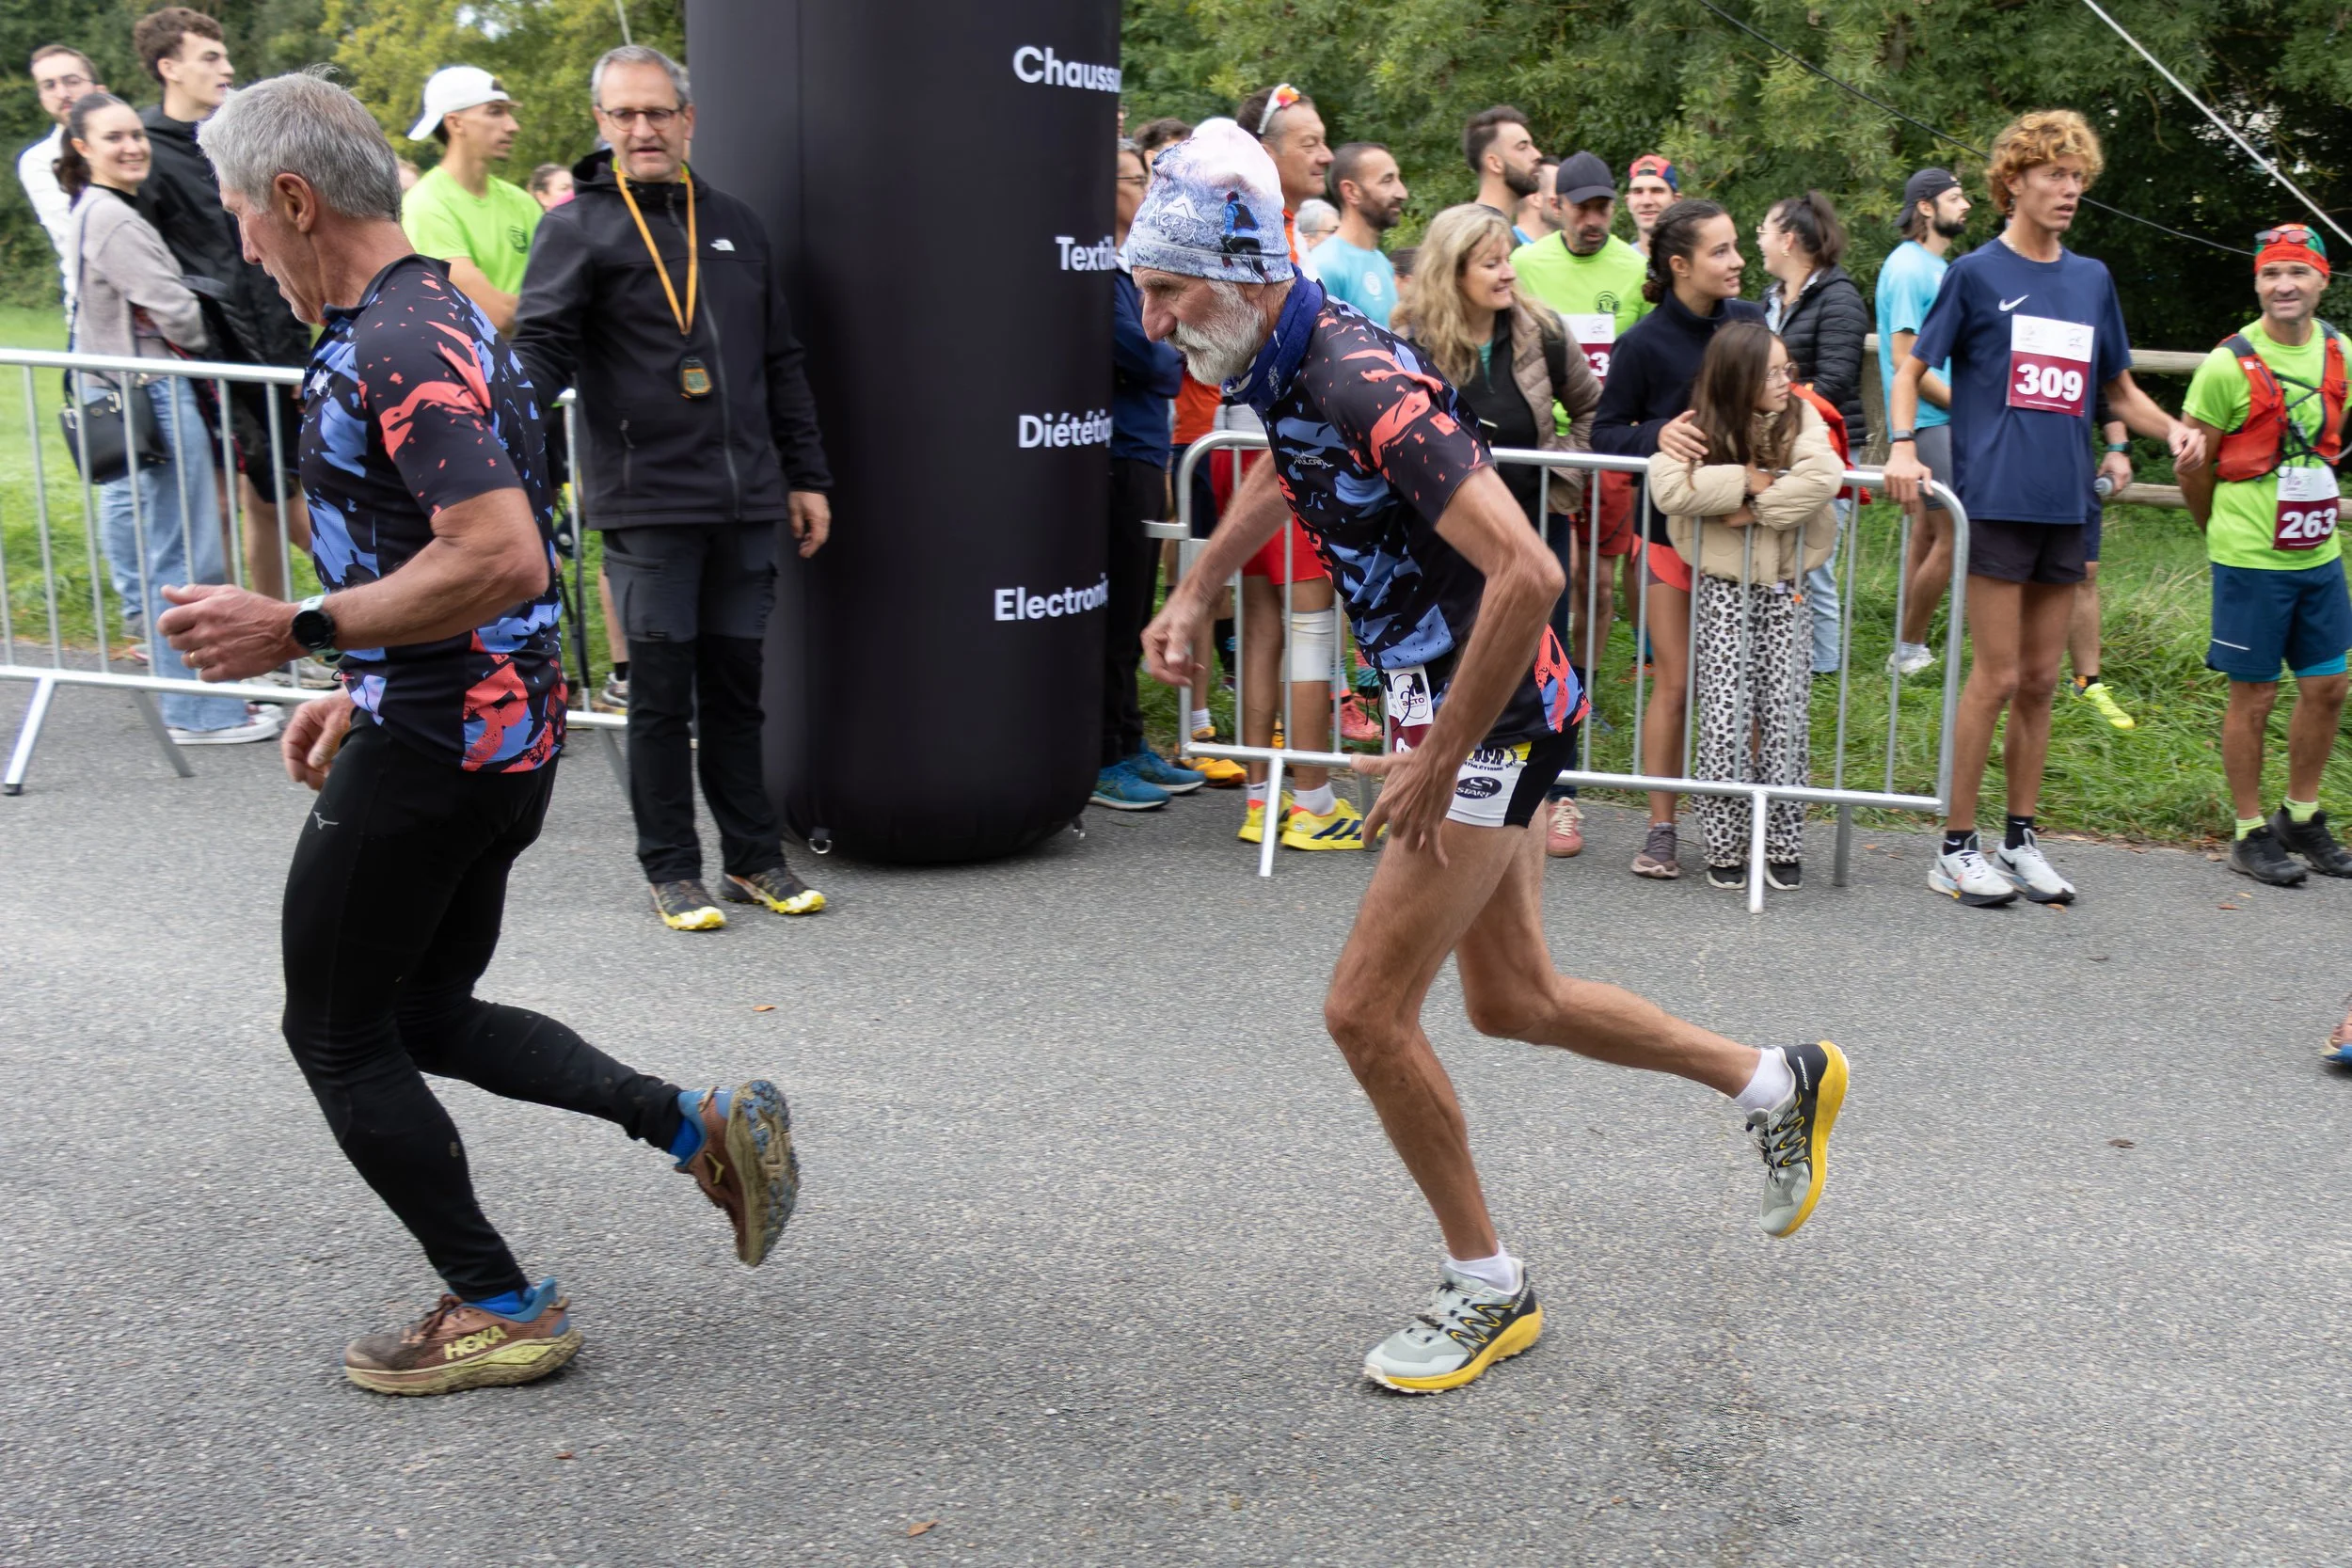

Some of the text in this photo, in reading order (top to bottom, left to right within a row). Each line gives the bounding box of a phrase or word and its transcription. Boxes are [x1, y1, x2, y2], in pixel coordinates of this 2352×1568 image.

[1583, 351, 1610, 377] 3
[2014, 363, 2084, 403] 309
[2278, 507, 2338, 539] 263
[443, 1324, 508, 1361] HOKA
